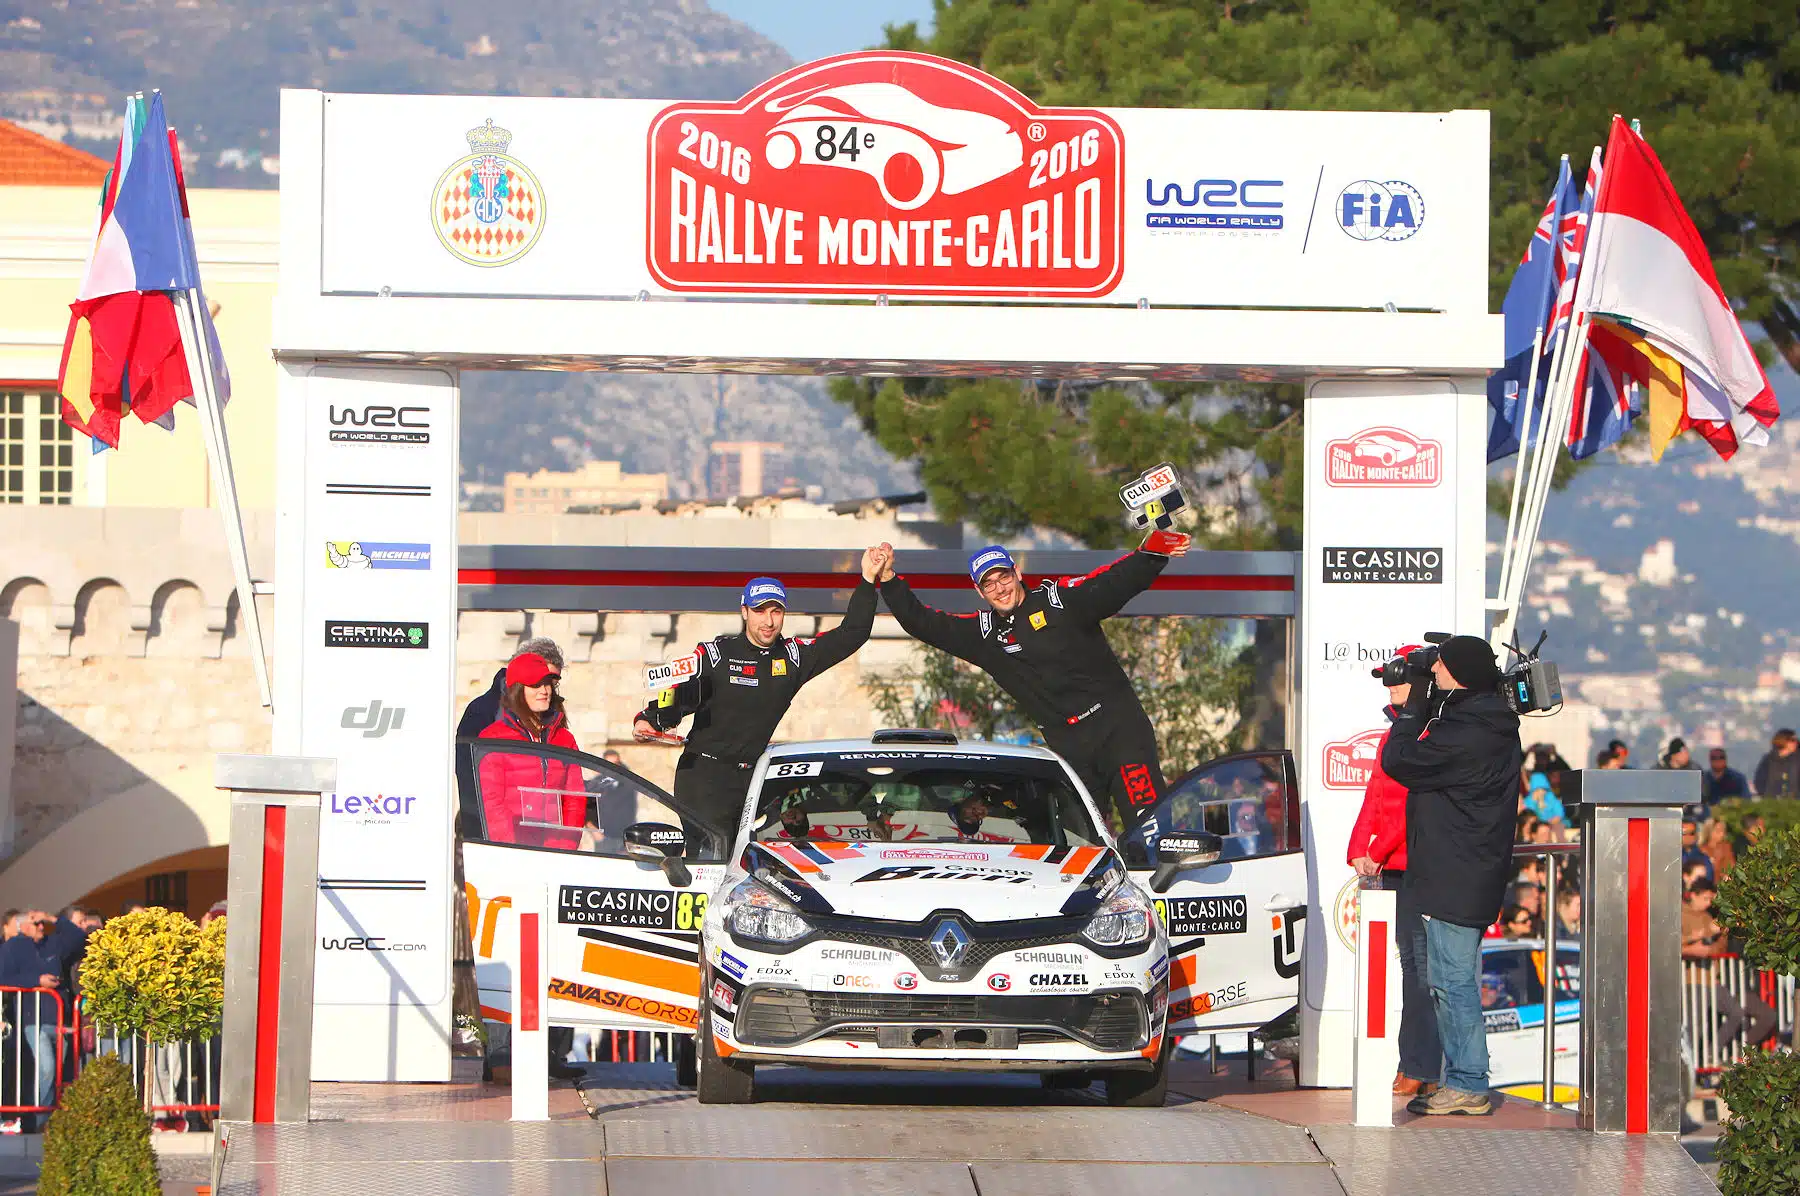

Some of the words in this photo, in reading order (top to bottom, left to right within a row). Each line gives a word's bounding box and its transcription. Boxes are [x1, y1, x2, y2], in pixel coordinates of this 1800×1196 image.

[679, 121, 752, 185] 2016
[1029, 128, 1100, 189] 2016
[1147, 179, 1284, 208] WRC
[670, 166, 804, 265] RALLYE
[818, 177, 1100, 269] MONTE-CARLO
[1149, 216, 1172, 225] FIA
[1174, 216, 1227, 225] WORLD
[1230, 217, 1281, 226] RALLY
[329, 404, 430, 428] WRC
[1331, 455, 1365, 480] RALLYE
[1366, 458, 1436, 480] MONTE-CARLO
[1127, 483, 1151, 500] CLIO
[370, 550, 430, 561] MICHELIN
[1325, 551, 1347, 568] LE
[1352, 550, 1440, 569] CASINO
[330, 625, 406, 637] CERTINA
[648, 666, 671, 680] CLIO
[839, 752, 920, 760] RENAULT
[923, 753, 997, 761] SPORT
[777, 763, 811, 776] 83
[1329, 758, 1363, 783] RALLYE
[331, 793, 417, 815] Lexar
[650, 831, 684, 840] CHAZEL
[1160, 838, 1199, 848] CHAZEL
[852, 866, 1031, 884] Burri
[945, 864, 1033, 876] Garage
[561, 889, 583, 907] LE
[586, 890, 670, 913] CASINO
[1170, 901, 1185, 920] LE
[1188, 899, 1245, 919] CASINO
[676, 892, 709, 930] 83
[821, 949, 893, 962] SCHAUBLIN
[1014, 952, 1083, 964] SCHAUBLIN
[756, 967, 793, 975] EDOX
[1029, 973, 1089, 986] CHAZEL
[714, 984, 733, 1004] ETS
